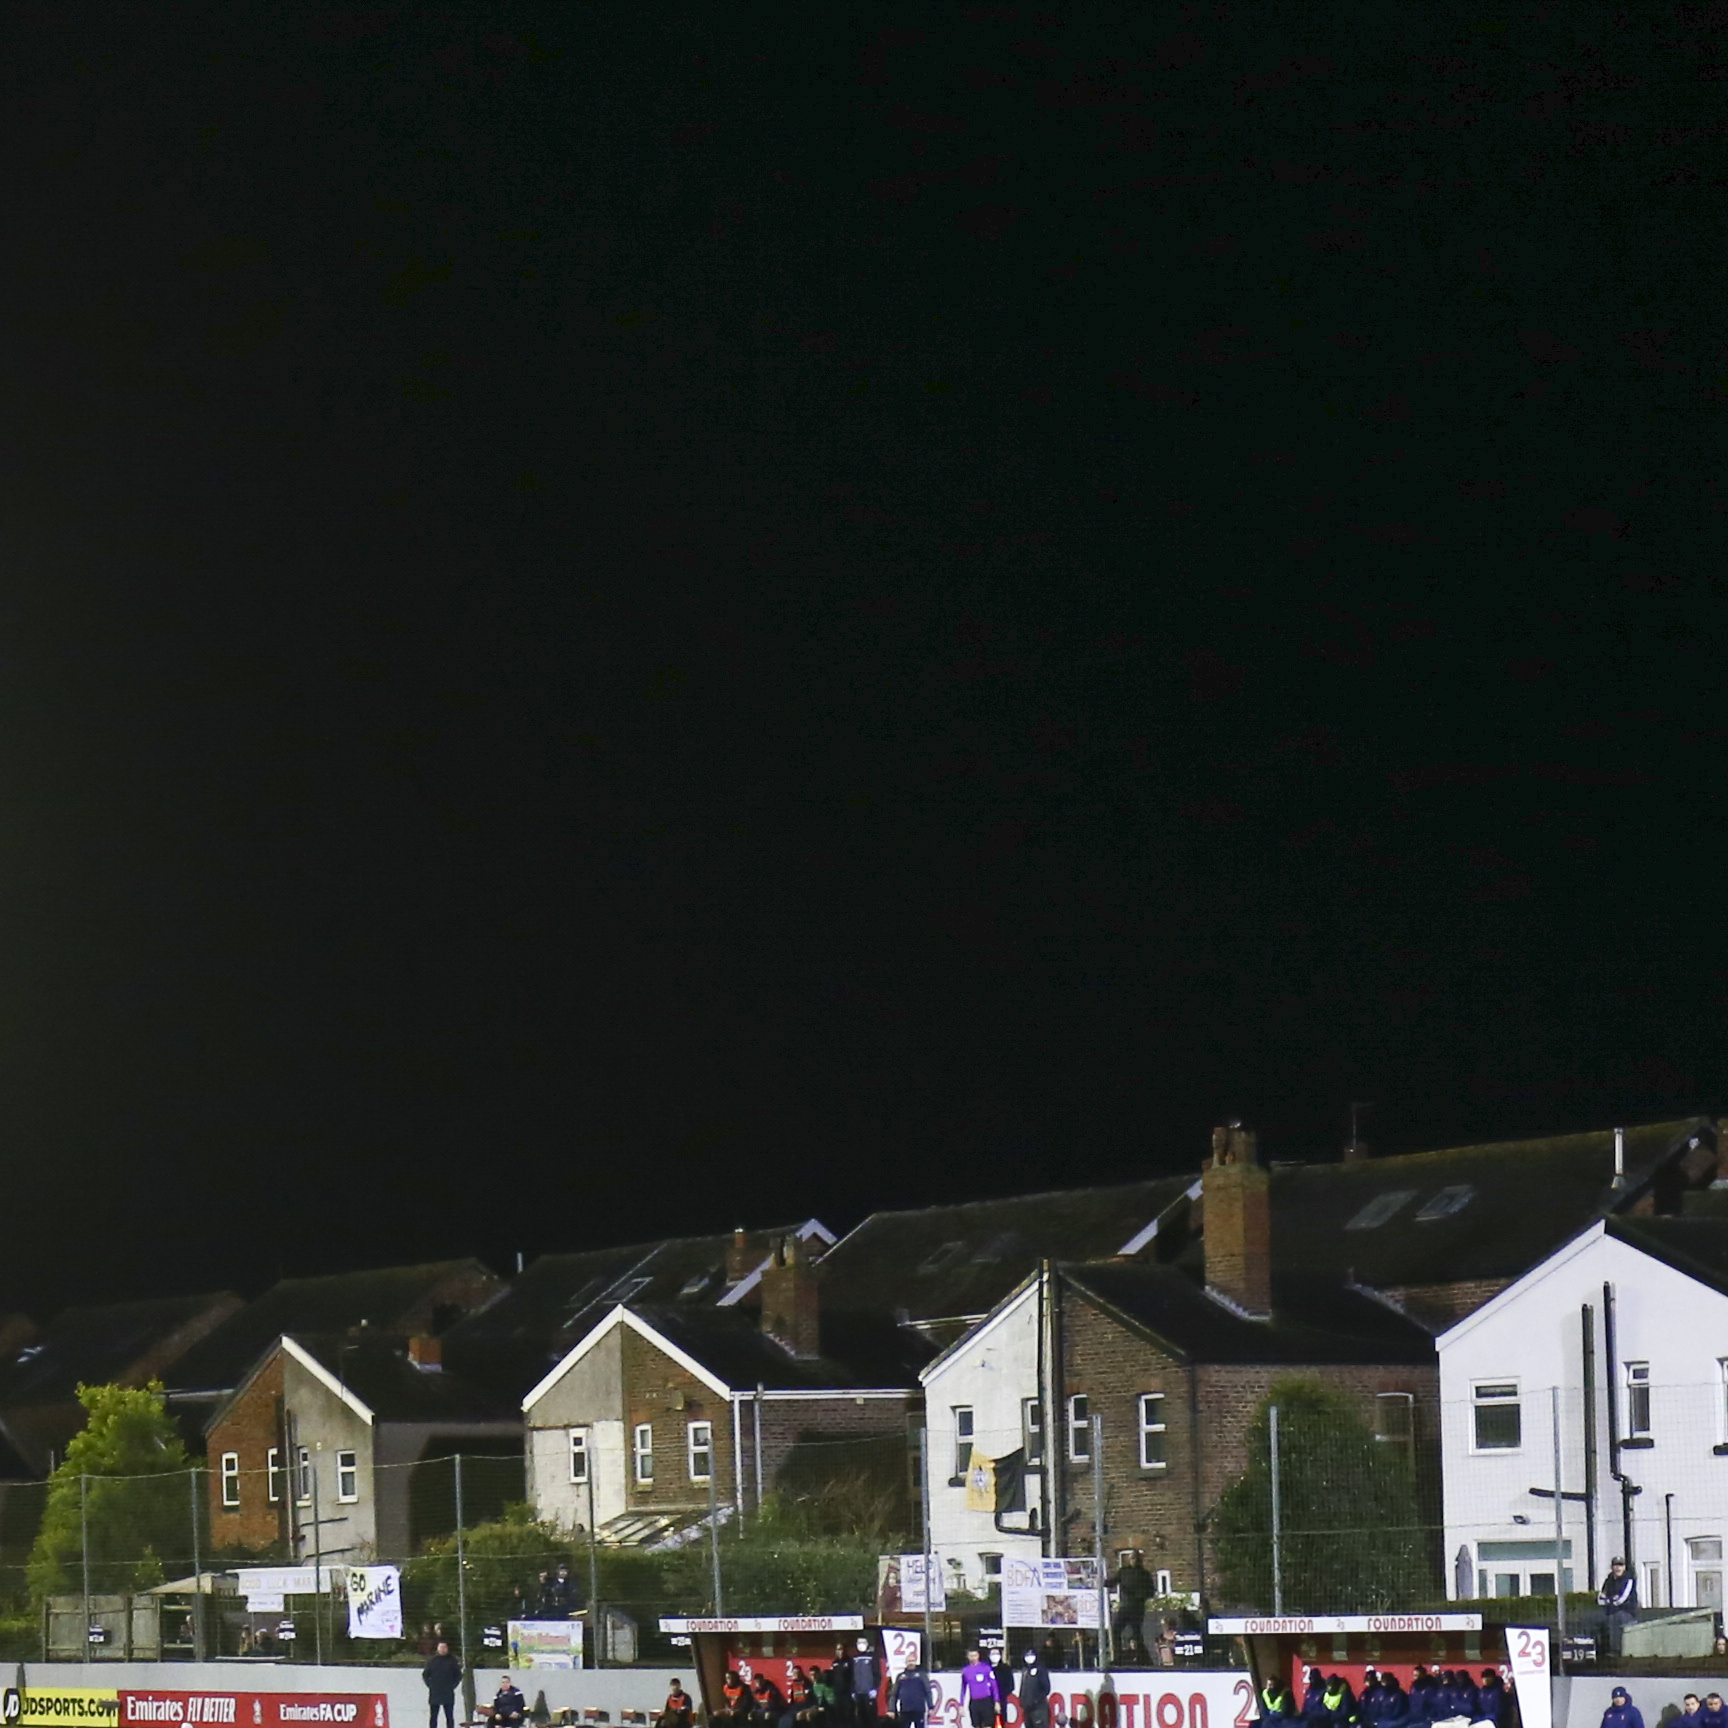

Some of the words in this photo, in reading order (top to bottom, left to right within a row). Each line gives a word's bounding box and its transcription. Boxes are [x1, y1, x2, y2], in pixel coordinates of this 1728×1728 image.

[349, 1572, 366, 1592] GO
[357, 1574, 395, 1626] MARINE
[1244, 1619, 1314, 1633] FOUNDATION
[1368, 1617, 1442, 1631] FOUNDATION
[1517, 1631, 1545, 1667] 23
[1573, 1649, 1584, 1661] 19
[126, 1695, 184, 1722] Emirates
[186, 1697, 204, 1722] FLY
[202, 1697, 237, 1723] BETTER
[279, 1703, 319, 1722] Emirates
[334, 1703, 358, 1722] CUP
